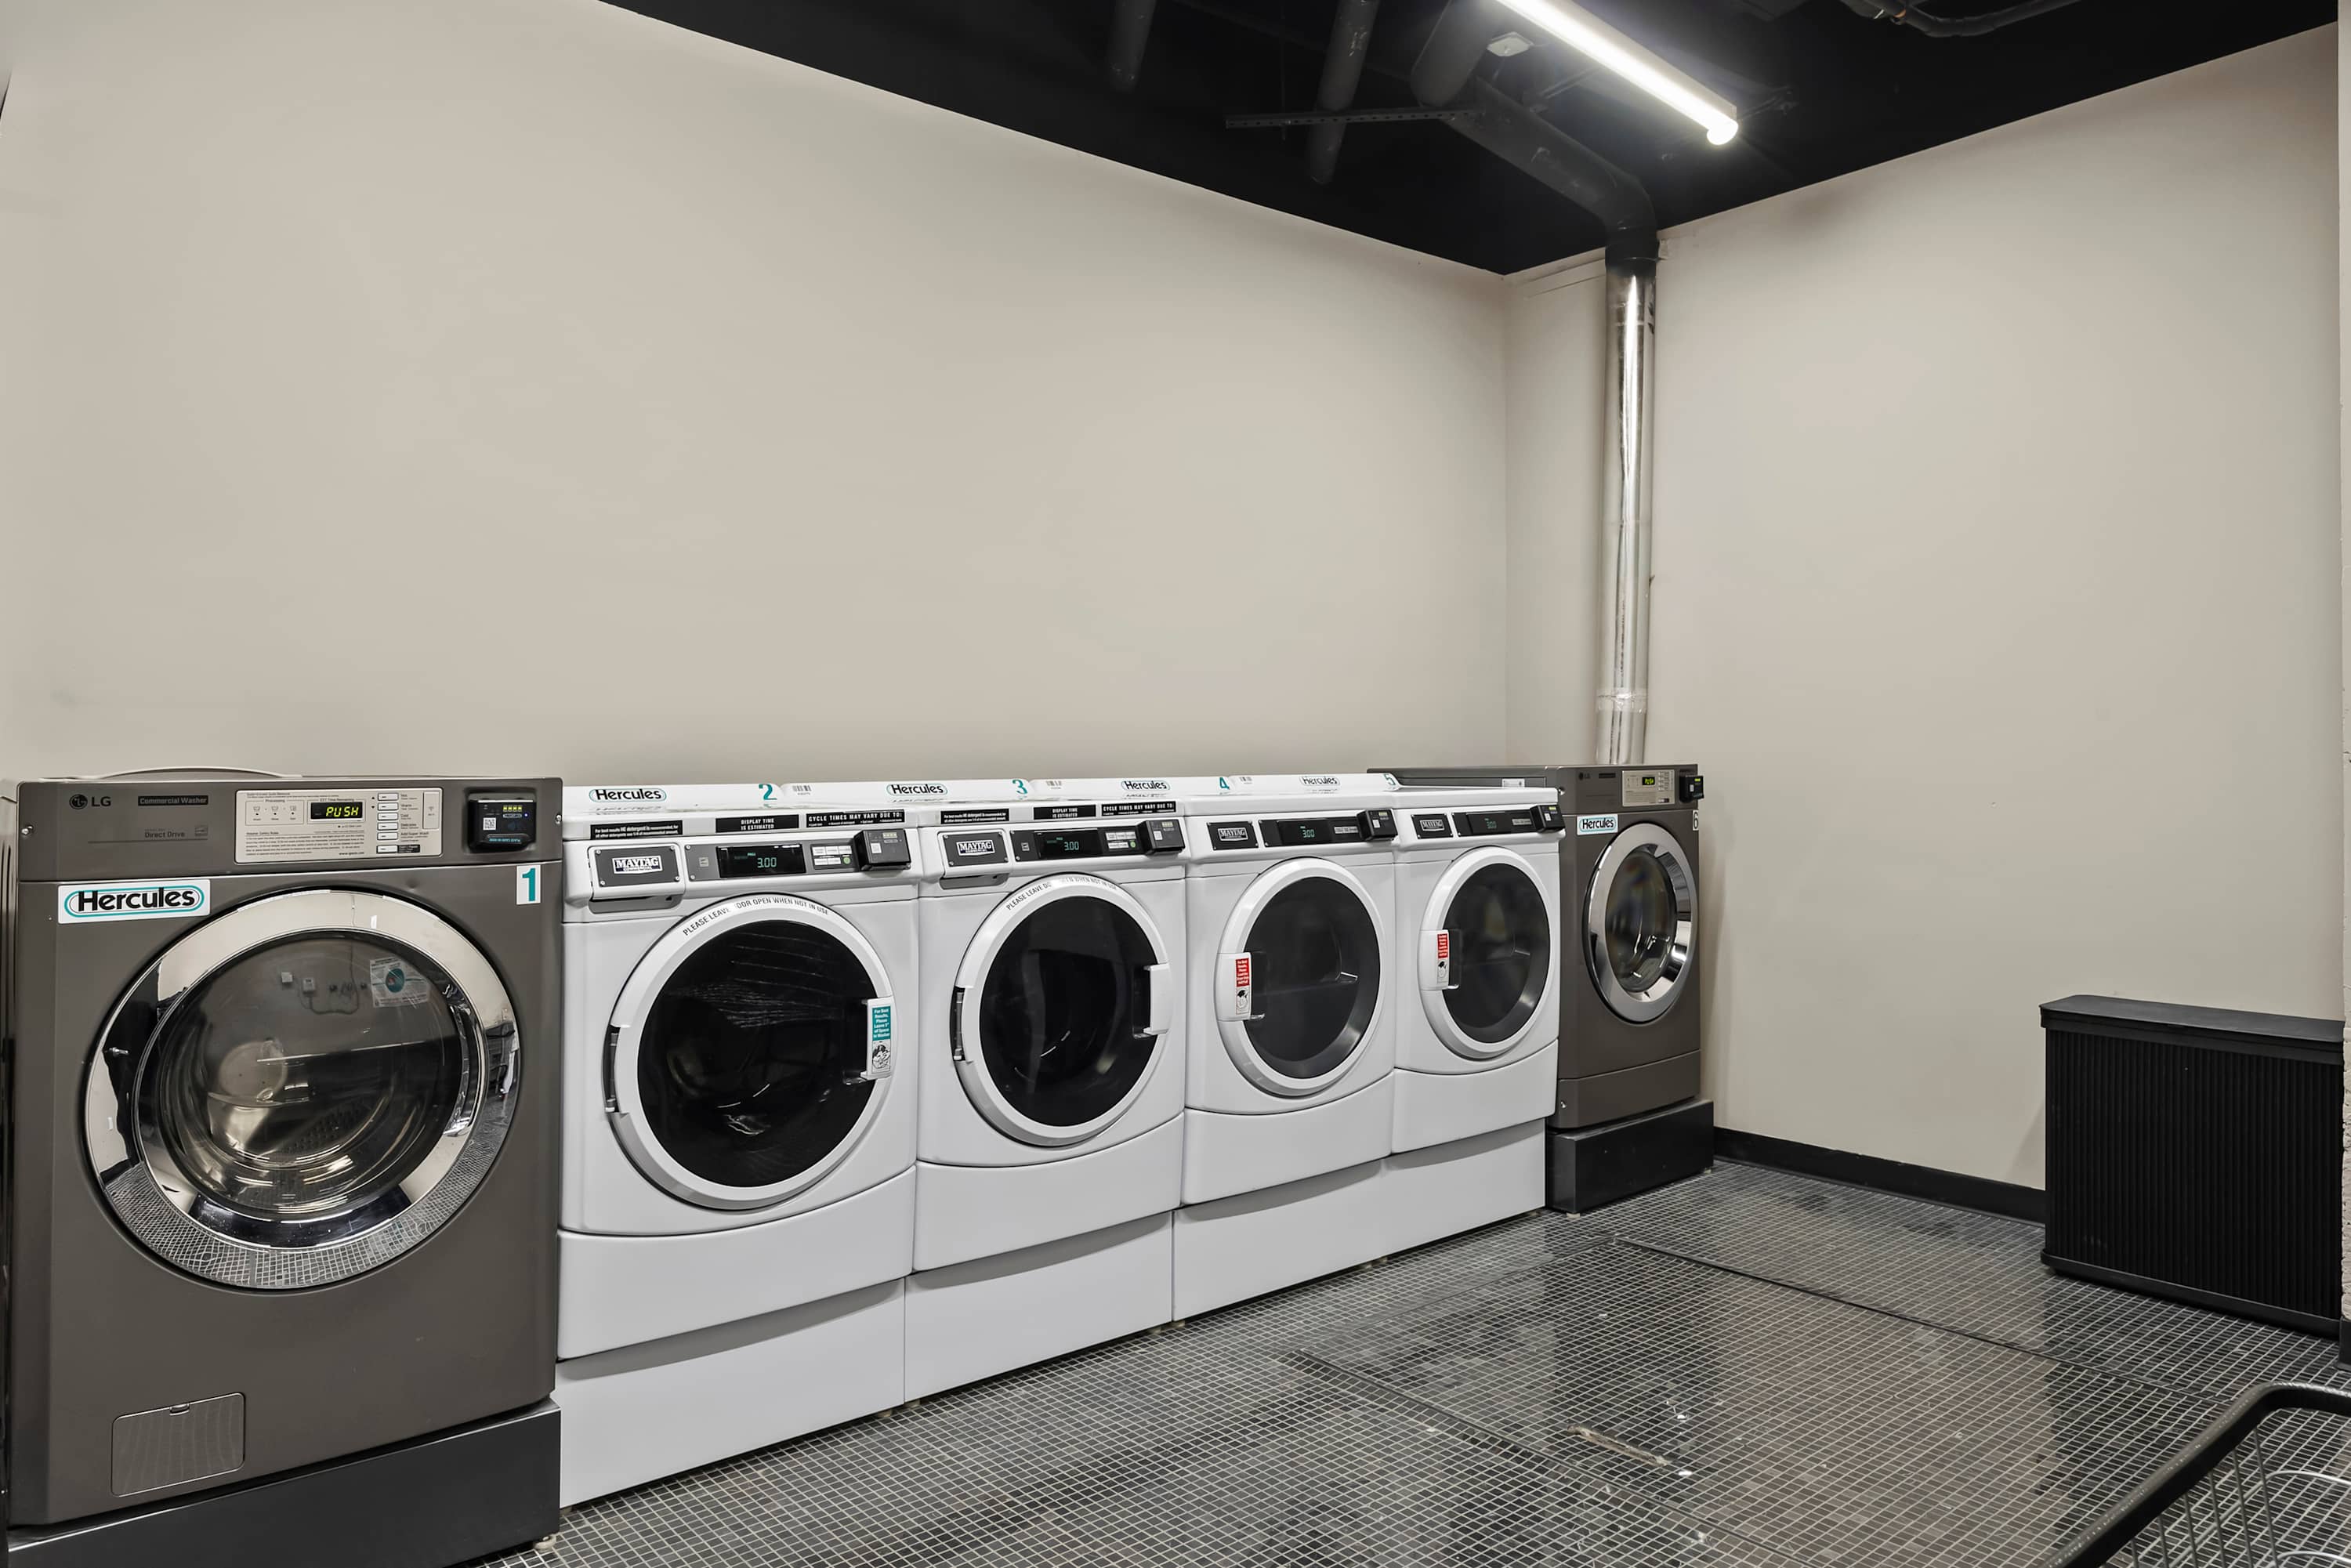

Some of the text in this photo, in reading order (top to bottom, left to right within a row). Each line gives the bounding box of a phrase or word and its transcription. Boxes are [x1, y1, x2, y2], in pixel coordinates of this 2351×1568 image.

[1124, 780, 1167, 790] Hercules
[1219, 777, 1230, 790] 4
[1301, 775, 1338, 784] Hercules
[758, 784, 777, 800] 2
[890, 784, 944, 794] Hercules
[1012, 779, 1028, 794] 3
[596, 788, 661, 800] Hercules
[92, 796, 111, 807] LG
[325, 806, 359, 817] PUSH
[1581, 817, 1614, 829] Hercules
[1693, 811, 1699, 829] 6
[1302, 829, 1315, 838] 3.00
[959, 842, 992, 851] MAYTAG
[1063, 841, 1080, 851] 3.00
[614, 857, 659, 869] MAYTAG
[757, 857, 777, 868] 3.00
[522, 867, 536, 901] 1
[78, 887, 195, 911] Hercules
[1006, 895, 1027, 911] PLEASE
[1027, 885, 1044, 897] LEAVE
[683, 917, 708, 936] PLEASE
[773, 896, 793, 905] WHEN
[794, 899, 807, 907] NOT
[817, 905, 829, 915] USE
